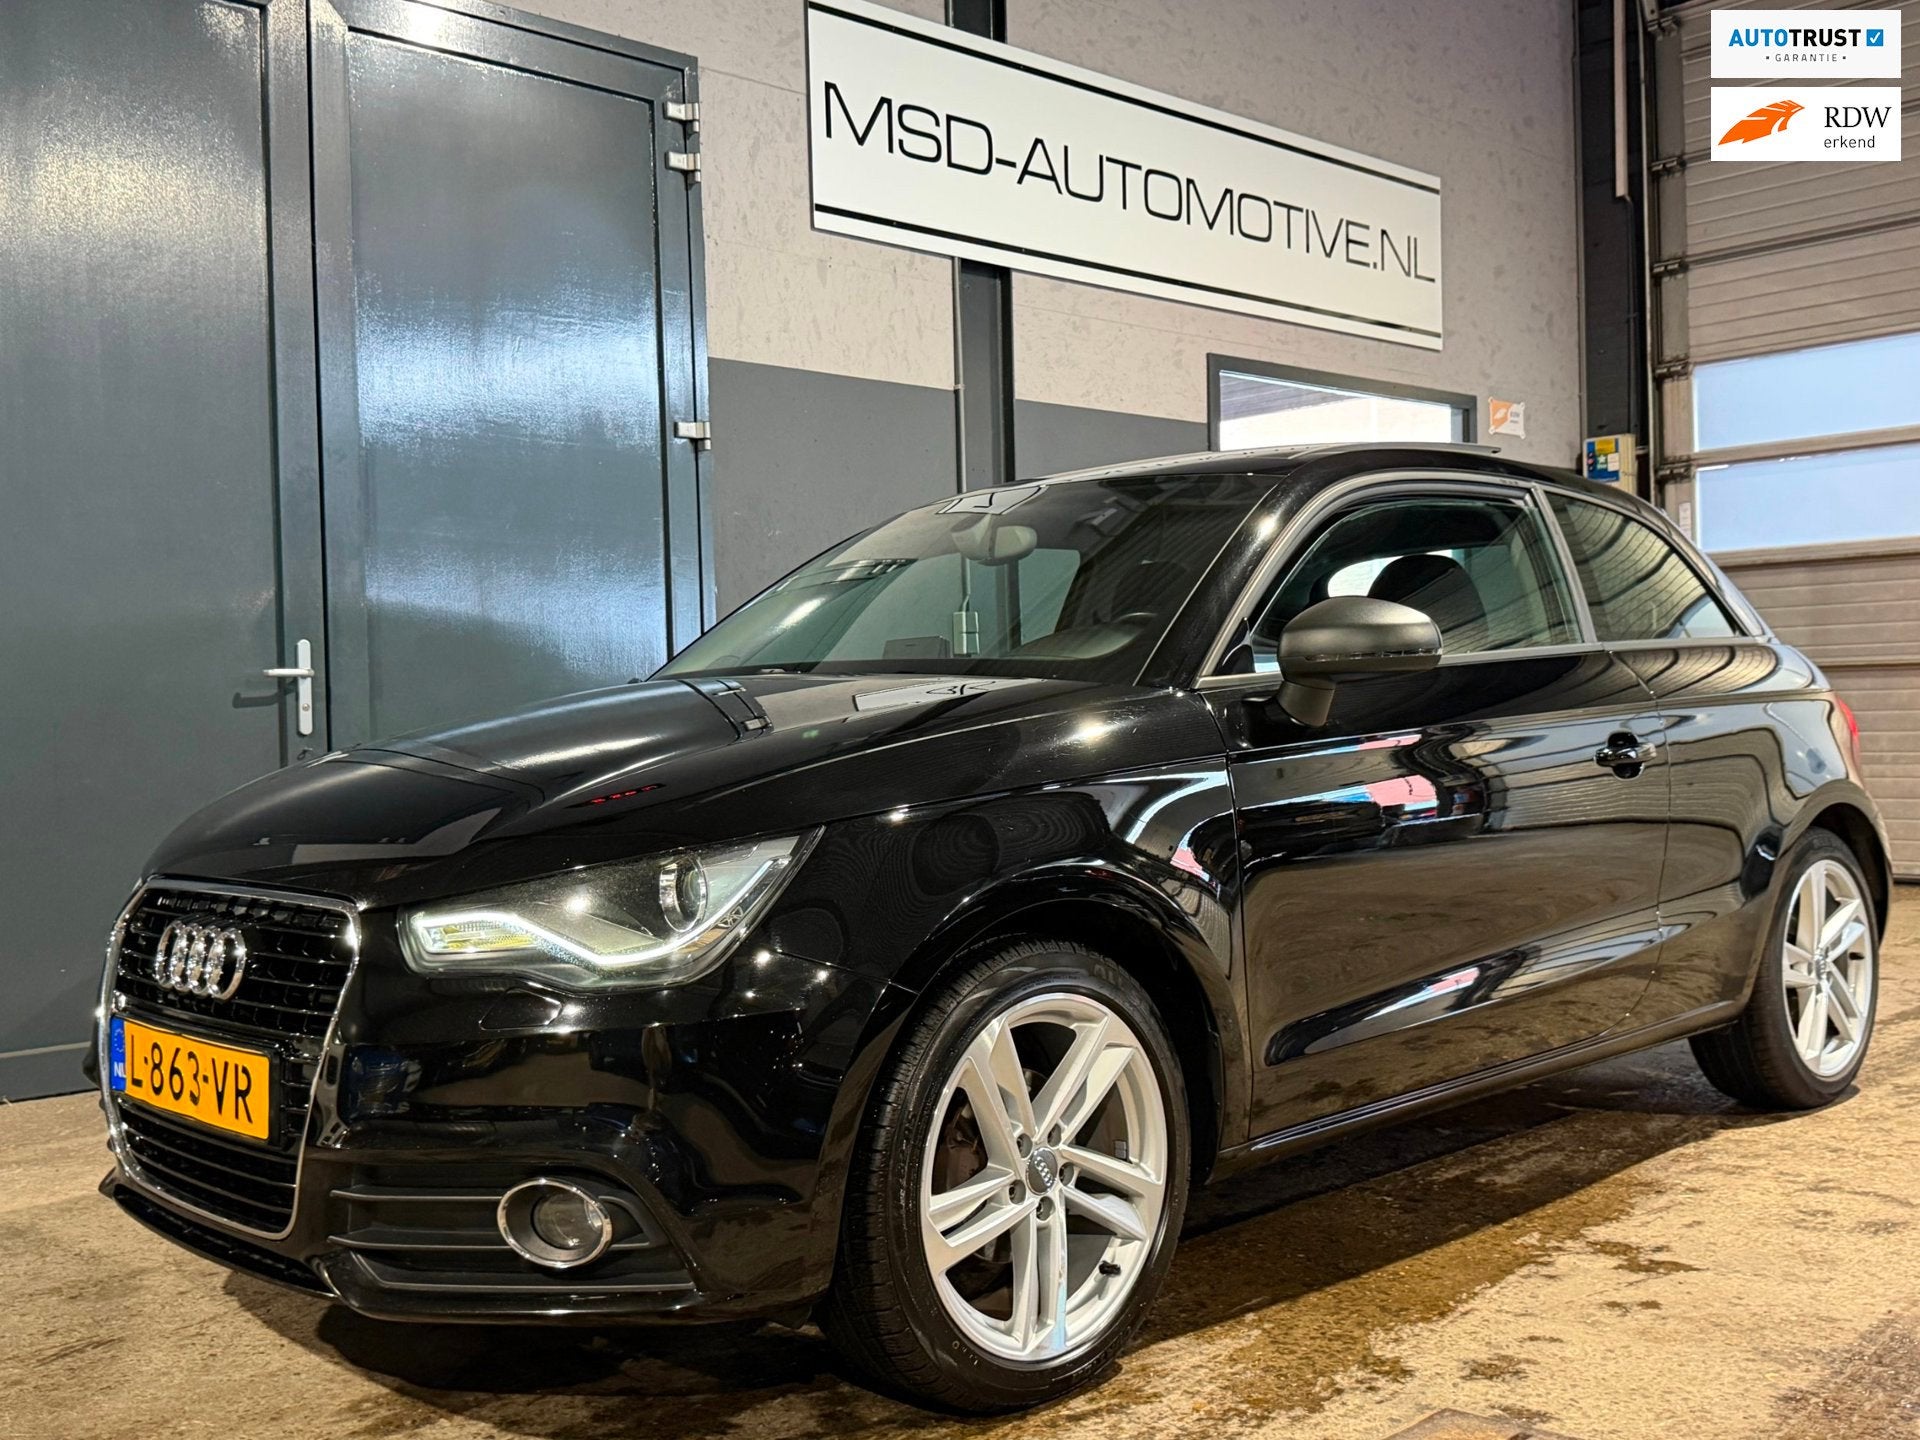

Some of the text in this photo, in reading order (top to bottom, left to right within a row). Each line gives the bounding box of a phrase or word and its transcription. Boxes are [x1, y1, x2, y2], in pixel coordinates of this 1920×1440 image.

[824, 80, 1436, 284] MSD-AUTOMOTIVE.NL
[114, 1061, 126, 1078] NL
[131, 1034, 253, 1124] L-863-VR
